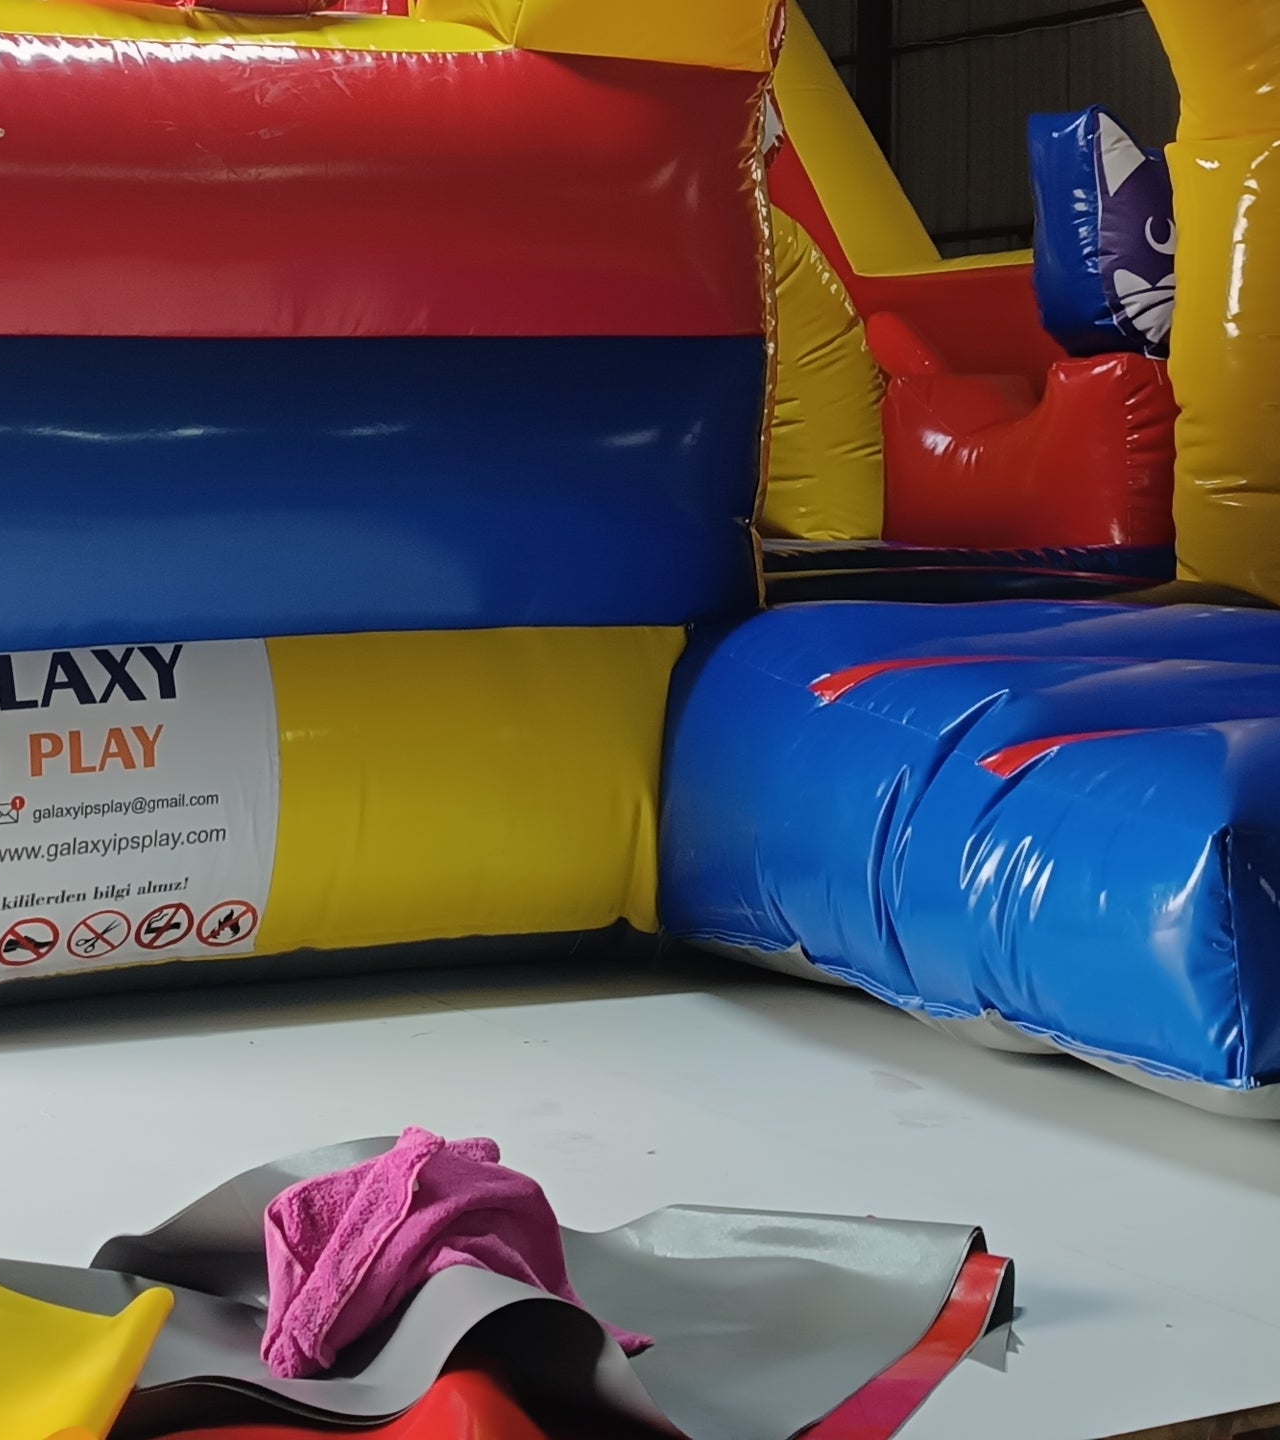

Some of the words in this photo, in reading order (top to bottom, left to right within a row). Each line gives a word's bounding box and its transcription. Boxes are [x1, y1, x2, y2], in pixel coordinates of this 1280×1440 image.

[28, 724, 164, 778] PLAY
[32, 793, 220, 823] galaxyipsplay@gmail.com
[93, 883, 132, 901] bilgi
[136, 876, 190, 896] alınız!
